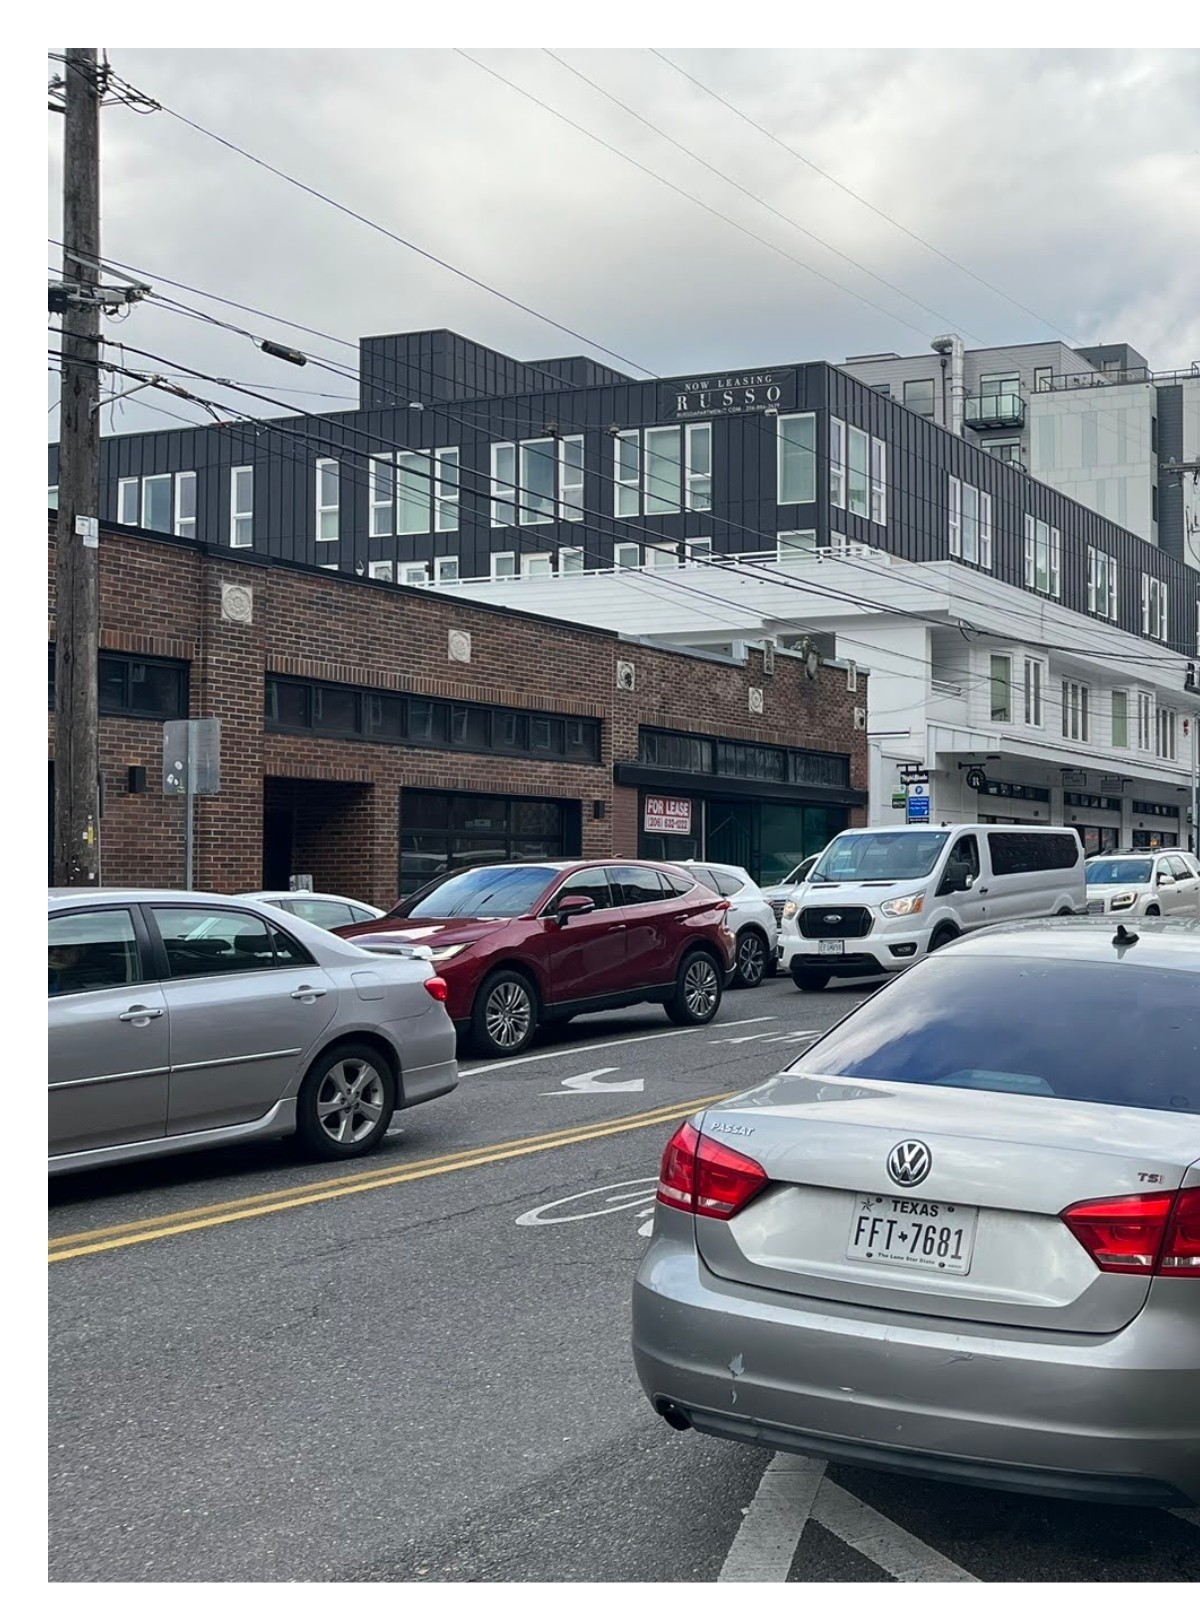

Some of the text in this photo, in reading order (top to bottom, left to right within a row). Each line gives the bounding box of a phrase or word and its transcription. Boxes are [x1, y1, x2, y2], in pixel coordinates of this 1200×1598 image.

[685, 375, 772, 391] NOW LEASING
[677, 386, 780, 411] RUSSO
[648, 799, 689, 817] FOR LEASE
[710, 1121, 755, 1136] PASSAT
[892, 1200, 939, 1217] TEXAS
